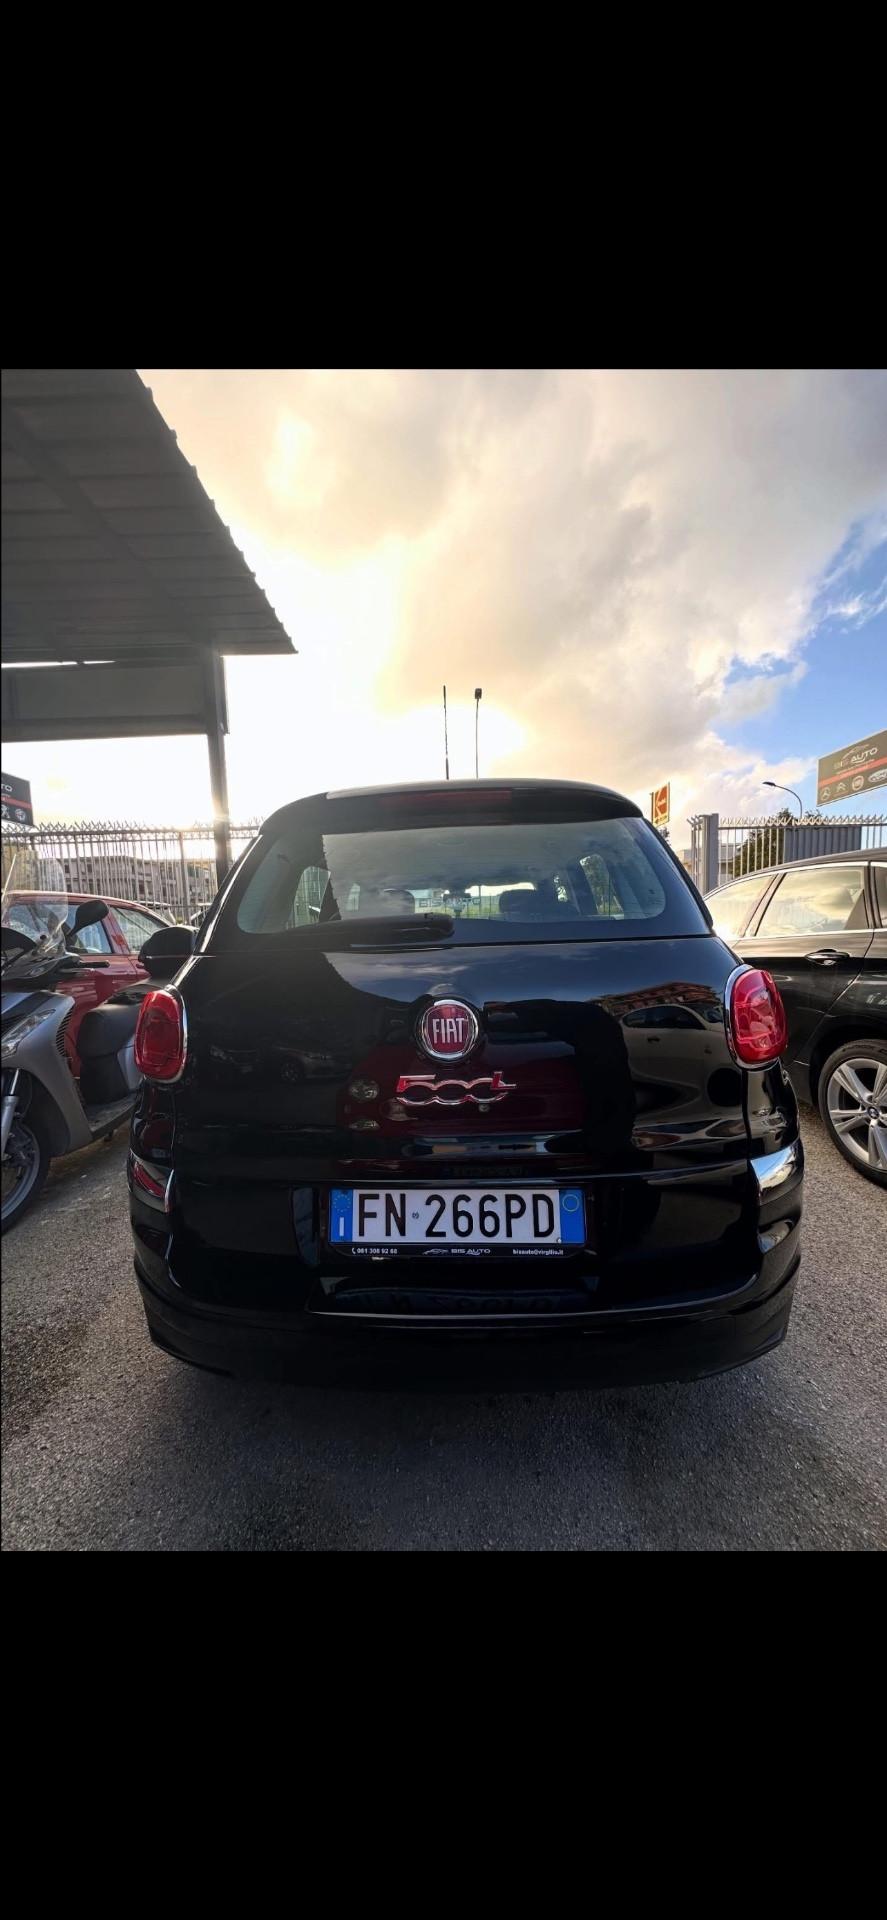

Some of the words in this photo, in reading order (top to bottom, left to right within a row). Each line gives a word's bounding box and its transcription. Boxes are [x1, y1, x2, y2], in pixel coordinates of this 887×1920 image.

[850, 747, 878, 763] AUTO
[432, 1017, 465, 1044] FIAT
[396, 1071, 517, 1105] 500L
[358, 1193, 406, 1237] FN
[424, 1193, 555, 1238] 266PD
